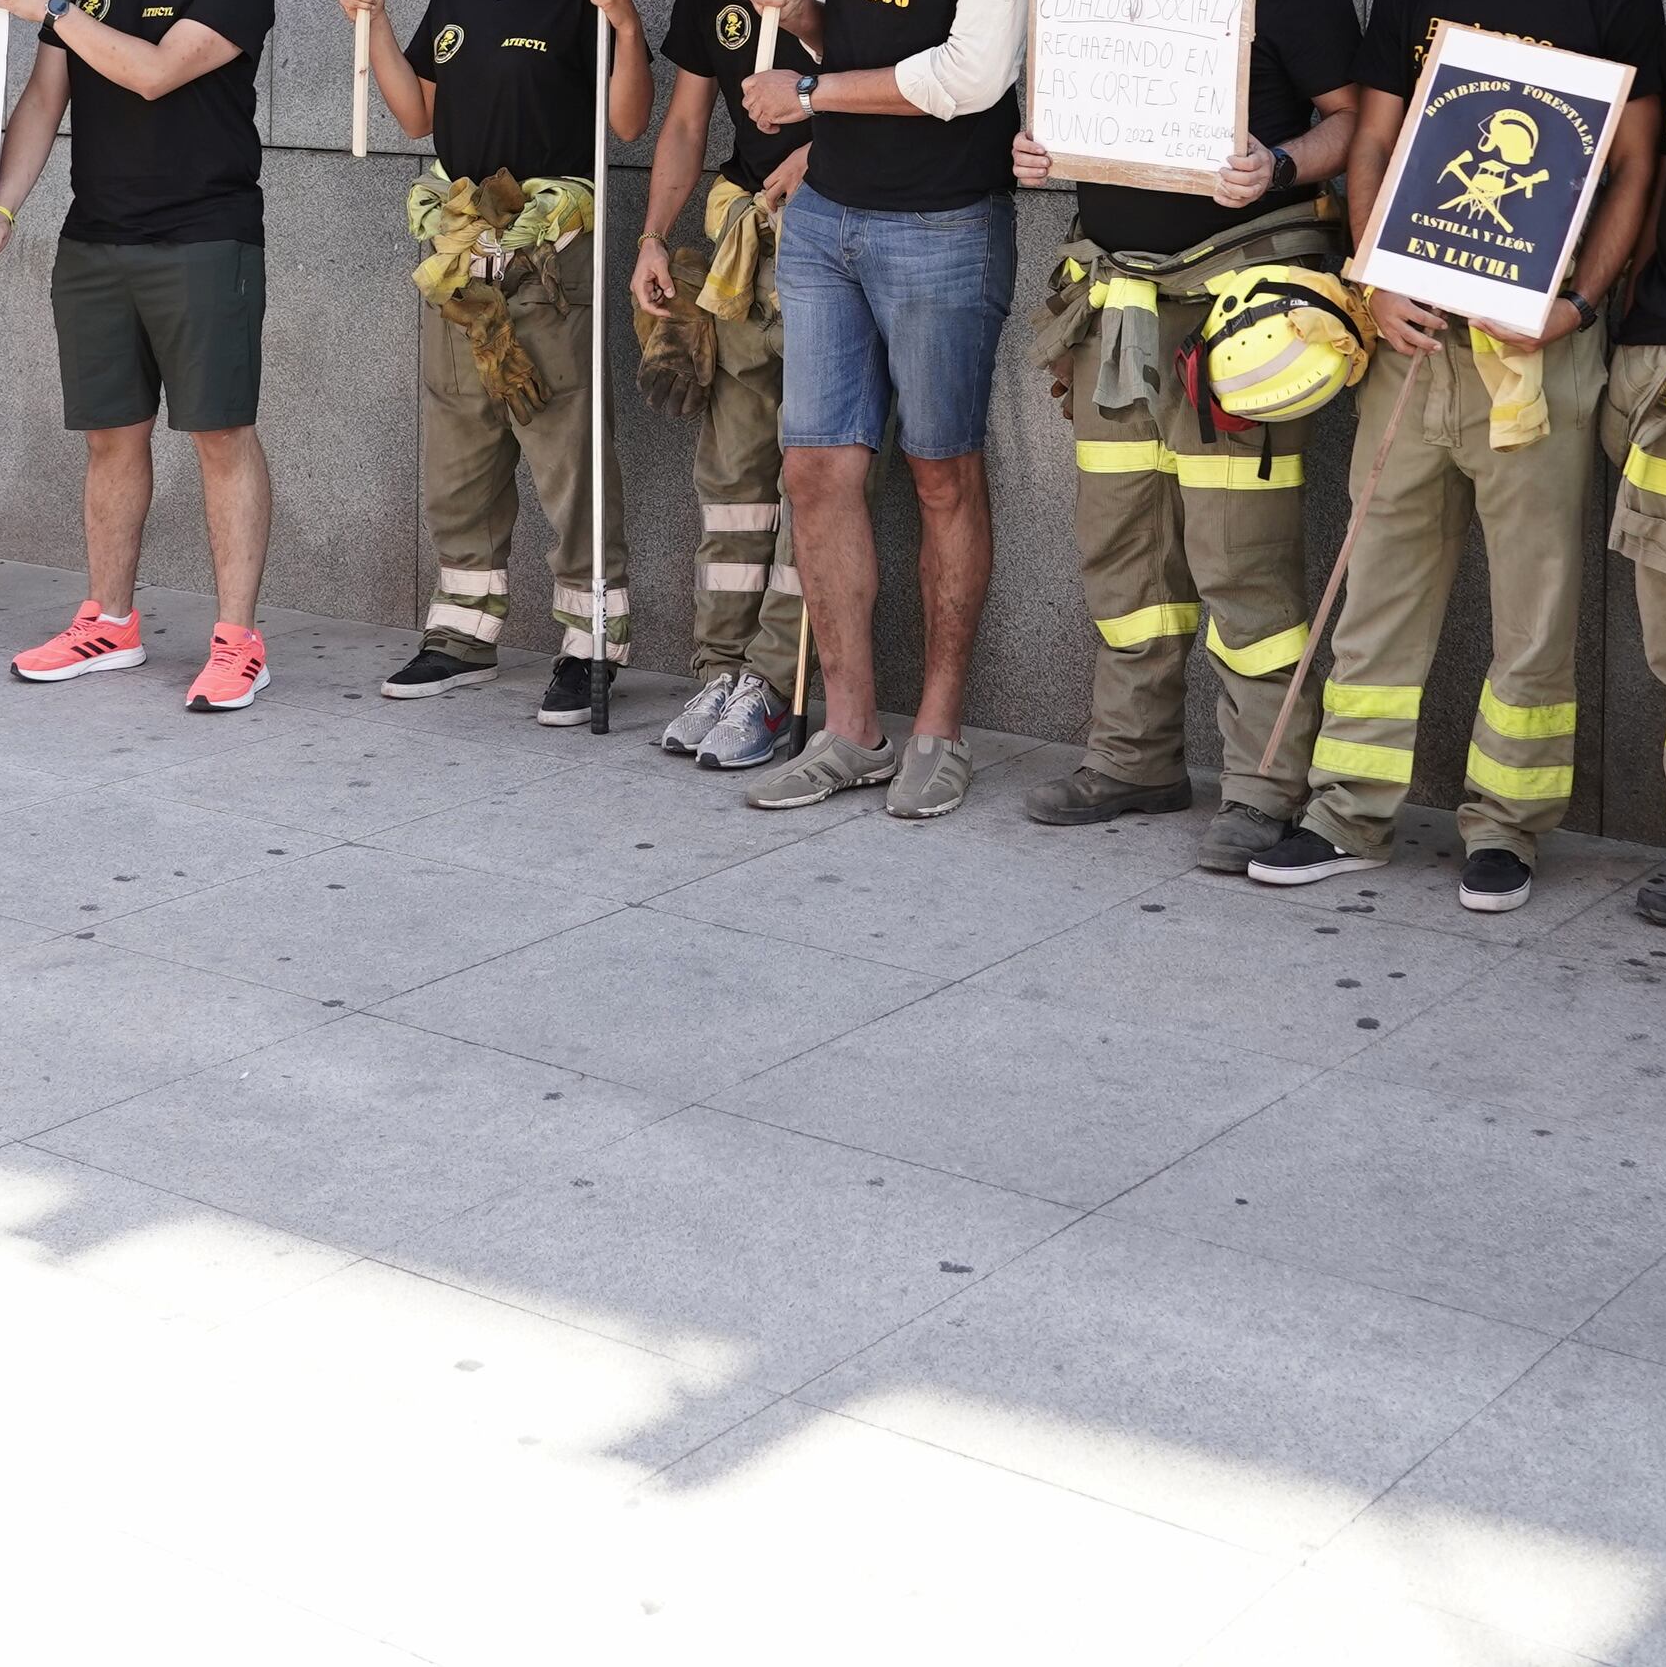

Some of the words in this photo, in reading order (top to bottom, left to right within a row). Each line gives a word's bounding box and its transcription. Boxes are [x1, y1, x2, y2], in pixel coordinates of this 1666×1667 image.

[500, 36, 548, 53] ATIFCYL
[1039, 31, 1175, 70] RECHAZANDO
[1184, 47, 1219, 77] EN
[1036, 68, 1078, 100] LAS
[1090, 71, 1179, 108] CORTES
[1193, 85, 1228, 116] EN
[1043, 108, 1120, 146] JUNIO
[1125, 128, 1155, 144] 2022
[1161, 121, 1181, 138] LA
[1423, 80, 1512, 119] BOMBEROS
[1521, 84, 1595, 158] FORESTALES
[1165, 142, 1222, 163] LEGAL
[1410, 211, 1479, 241] CASTILLA
[1482, 230, 1495, 246] Y
[1495, 233, 1536, 255] LEÓN
[1406, 236, 1440, 260] EN
[1443, 247, 1521, 282] LUCHA
